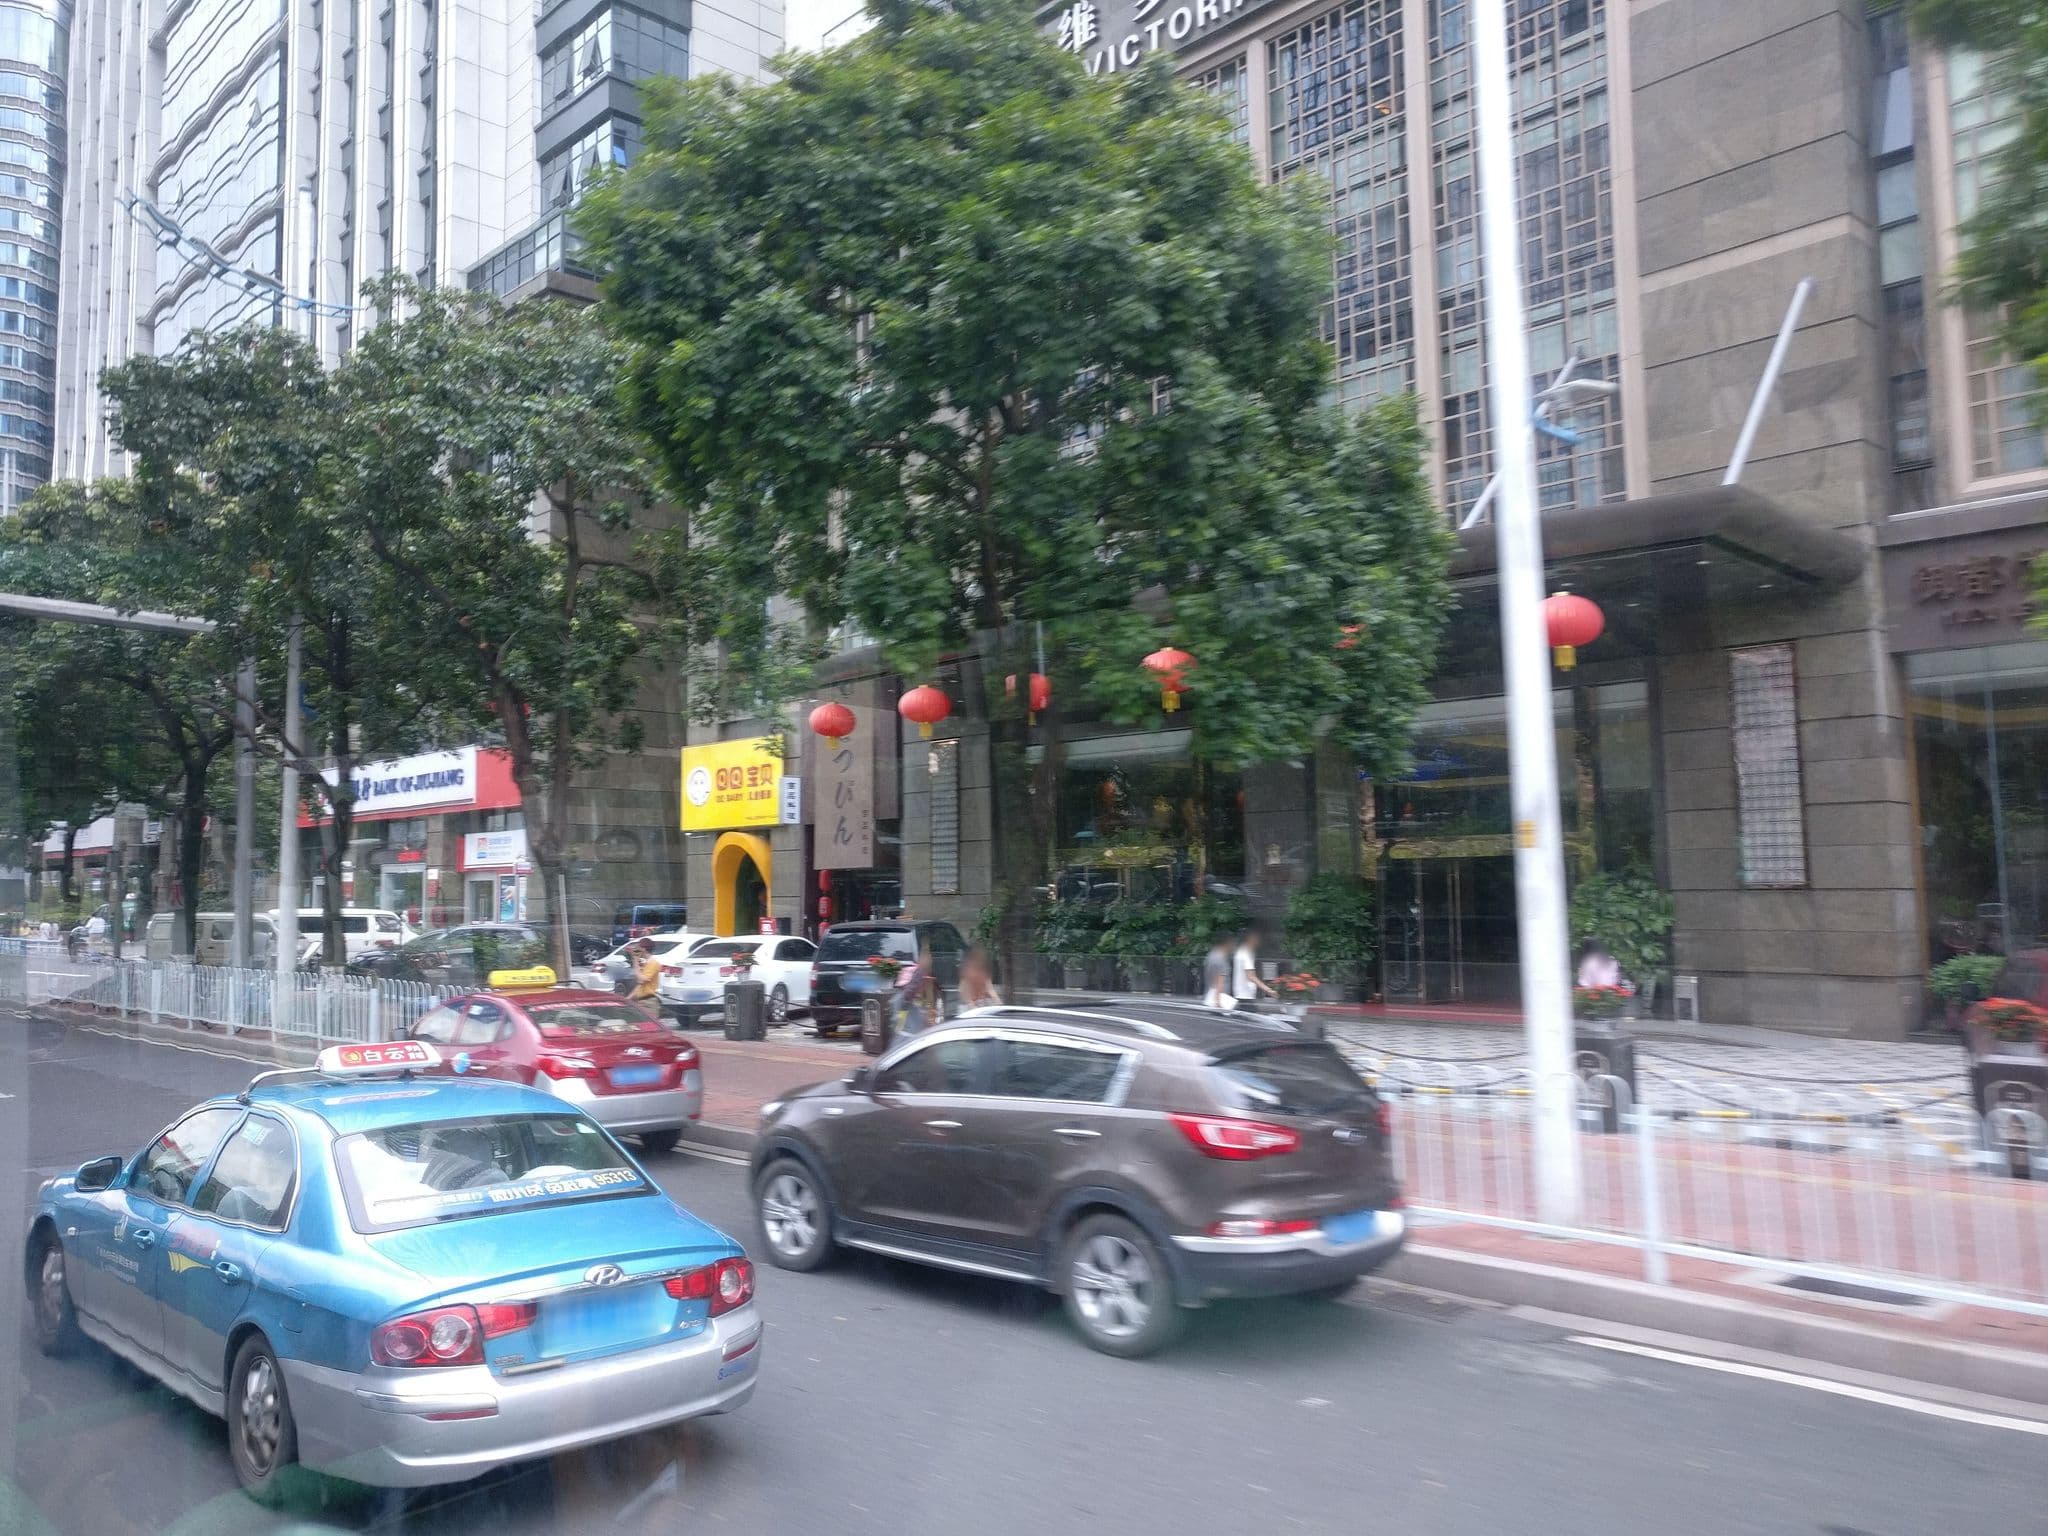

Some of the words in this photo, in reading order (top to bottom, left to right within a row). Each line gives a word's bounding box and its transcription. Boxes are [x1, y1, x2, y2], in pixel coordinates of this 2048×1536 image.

[374, 779, 398, 796] BANK
[400, 776, 414, 792] OF
[415, 769, 463, 790] JIUJIANG
[832, 735, 855, 846] つびん
[593, 1170, 637, 1187] 95313
